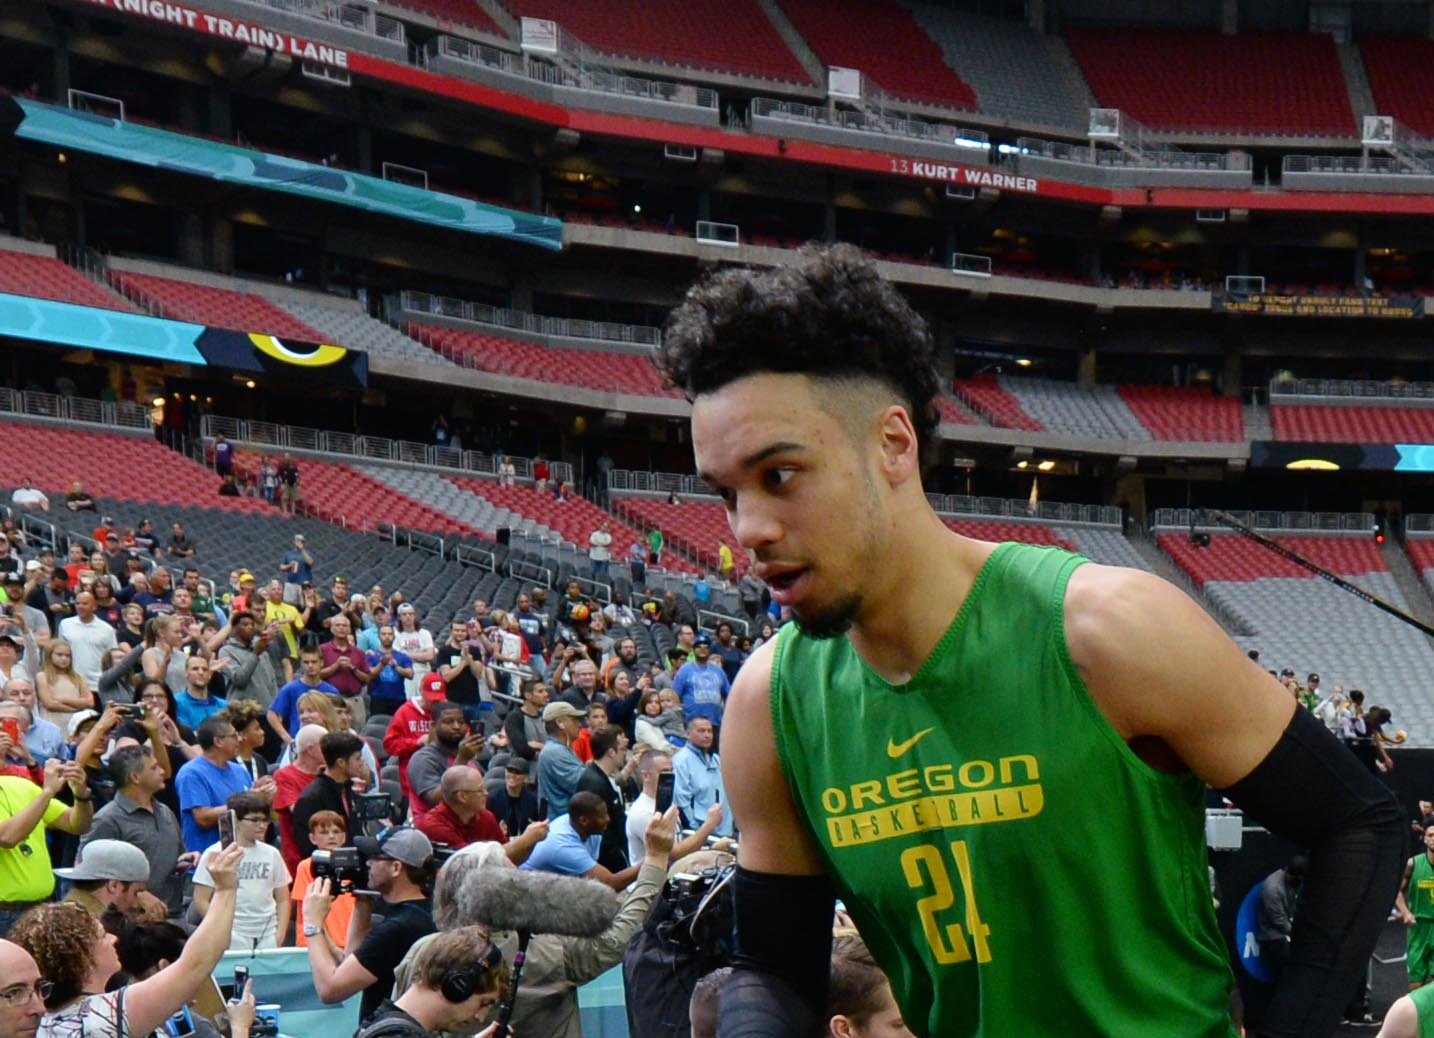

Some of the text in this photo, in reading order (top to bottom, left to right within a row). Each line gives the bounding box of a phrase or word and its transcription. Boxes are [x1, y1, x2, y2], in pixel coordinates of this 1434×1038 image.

[203, 14, 283, 51] TRAIN)
[290, 38, 348, 67] LANE
[890, 160, 1038, 192] 13 KURT WARNER
[821, 754, 1040, 814] OREGON
[833, 789, 1031, 842] BASKEBALL
